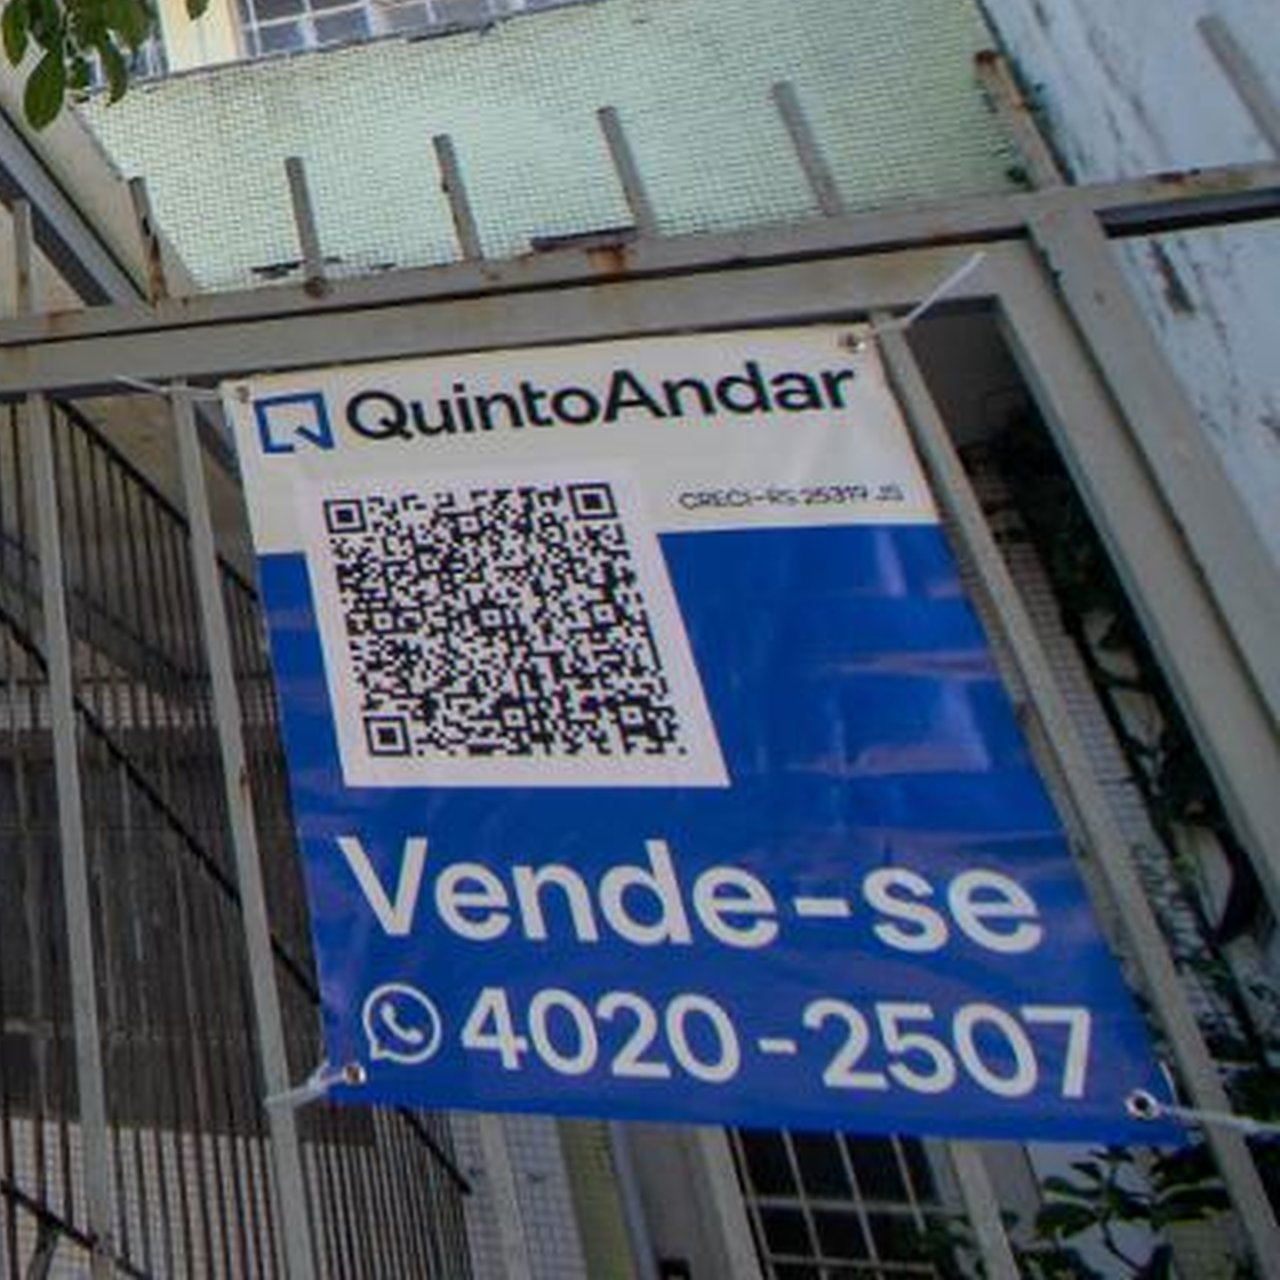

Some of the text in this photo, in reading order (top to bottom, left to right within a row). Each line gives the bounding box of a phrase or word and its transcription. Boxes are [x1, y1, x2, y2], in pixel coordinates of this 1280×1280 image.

[346, 360, 854, 441] QuintoAndar
[336, 836, 1042, 951] Vende-se
[459, 987, 1091, 1098] 4020-2507
